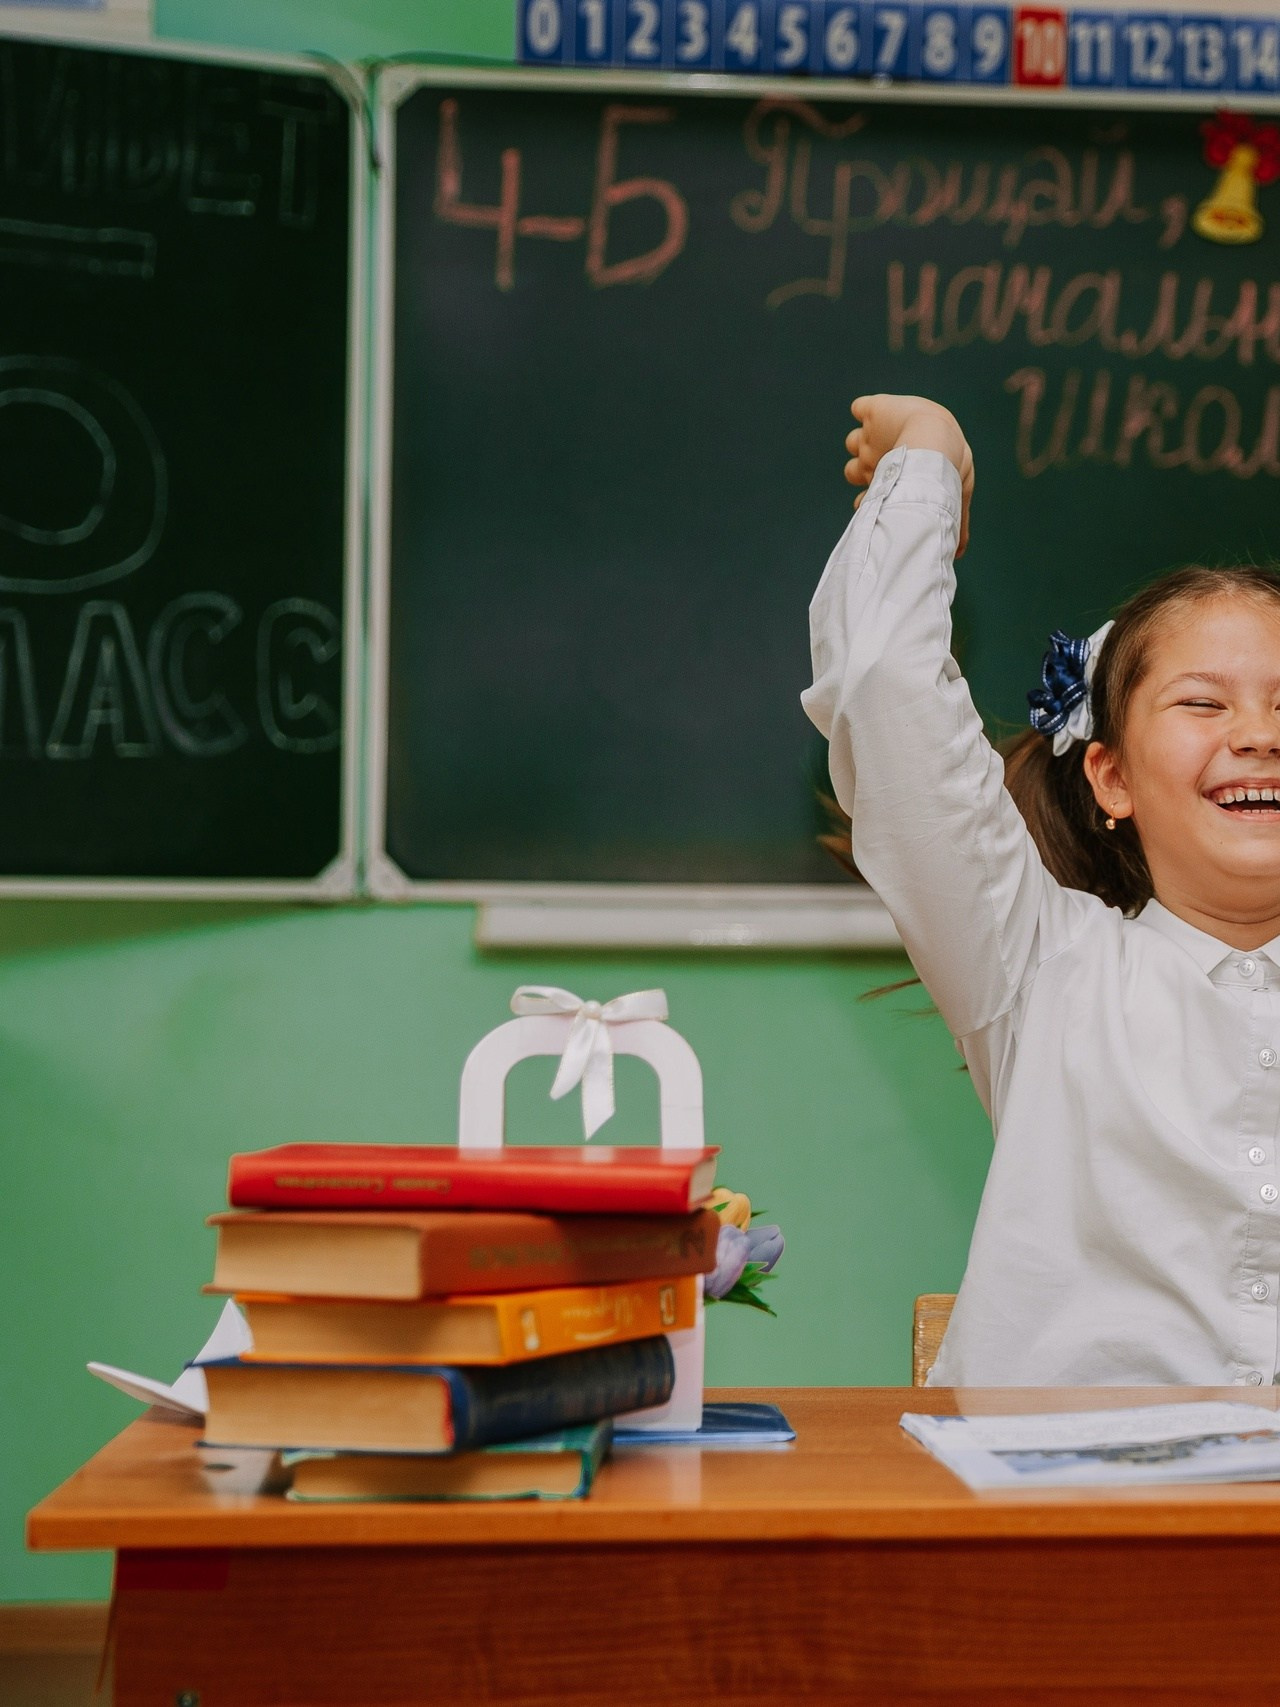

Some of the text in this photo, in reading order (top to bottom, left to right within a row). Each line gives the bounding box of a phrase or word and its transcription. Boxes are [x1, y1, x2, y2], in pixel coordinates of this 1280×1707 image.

[527, 0, 560, 55] 0
[579, 2, 605, 57] 1
[627, 3, 661, 59] 2
[675, 4, 709, 62] 3
[726, 4, 760, 64] 4
[775, 5, 808, 67] 5
[824, 8, 859, 70] 6
[873, 9, 907, 72] 7
[923, 11, 958, 75] 8
[972, 13, 1006, 77] 9
[1017, 17, 1062, 80] 10
[1073, 21, 1114, 81] 11
[1124, 22, 1173, 83] 12
[1179, 24, 1226, 85] 13
